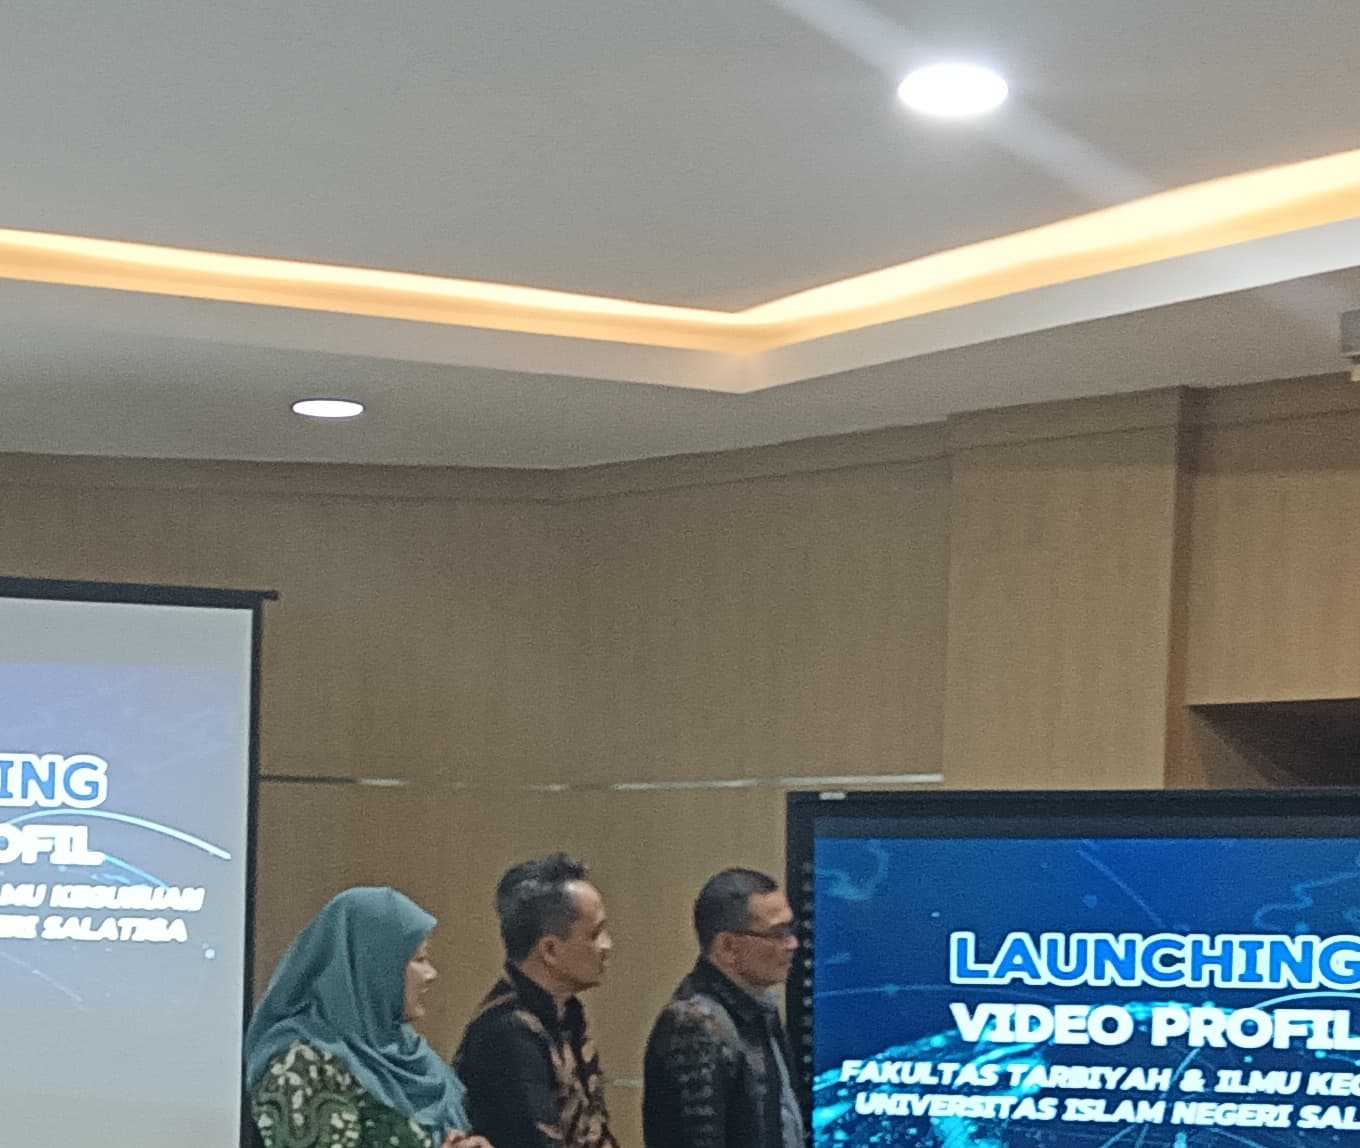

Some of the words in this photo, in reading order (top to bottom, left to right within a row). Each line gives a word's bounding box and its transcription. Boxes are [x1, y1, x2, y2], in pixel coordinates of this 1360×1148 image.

[949, 1001, 1135, 1047] VIDEO
[840, 1059, 1000, 1087] FAKULTAS
[1006, 1063, 1173, 1092] TARBIYAH
[1179, 1068, 1206, 1093] &
[1213, 1068, 1303, 1096] ILMU
[854, 1091, 1059, 1121] UNIVERSITAS
[1061, 1097, 1167, 1125] ISLAM
[1170, 1100, 1294, 1129] NEGERI
